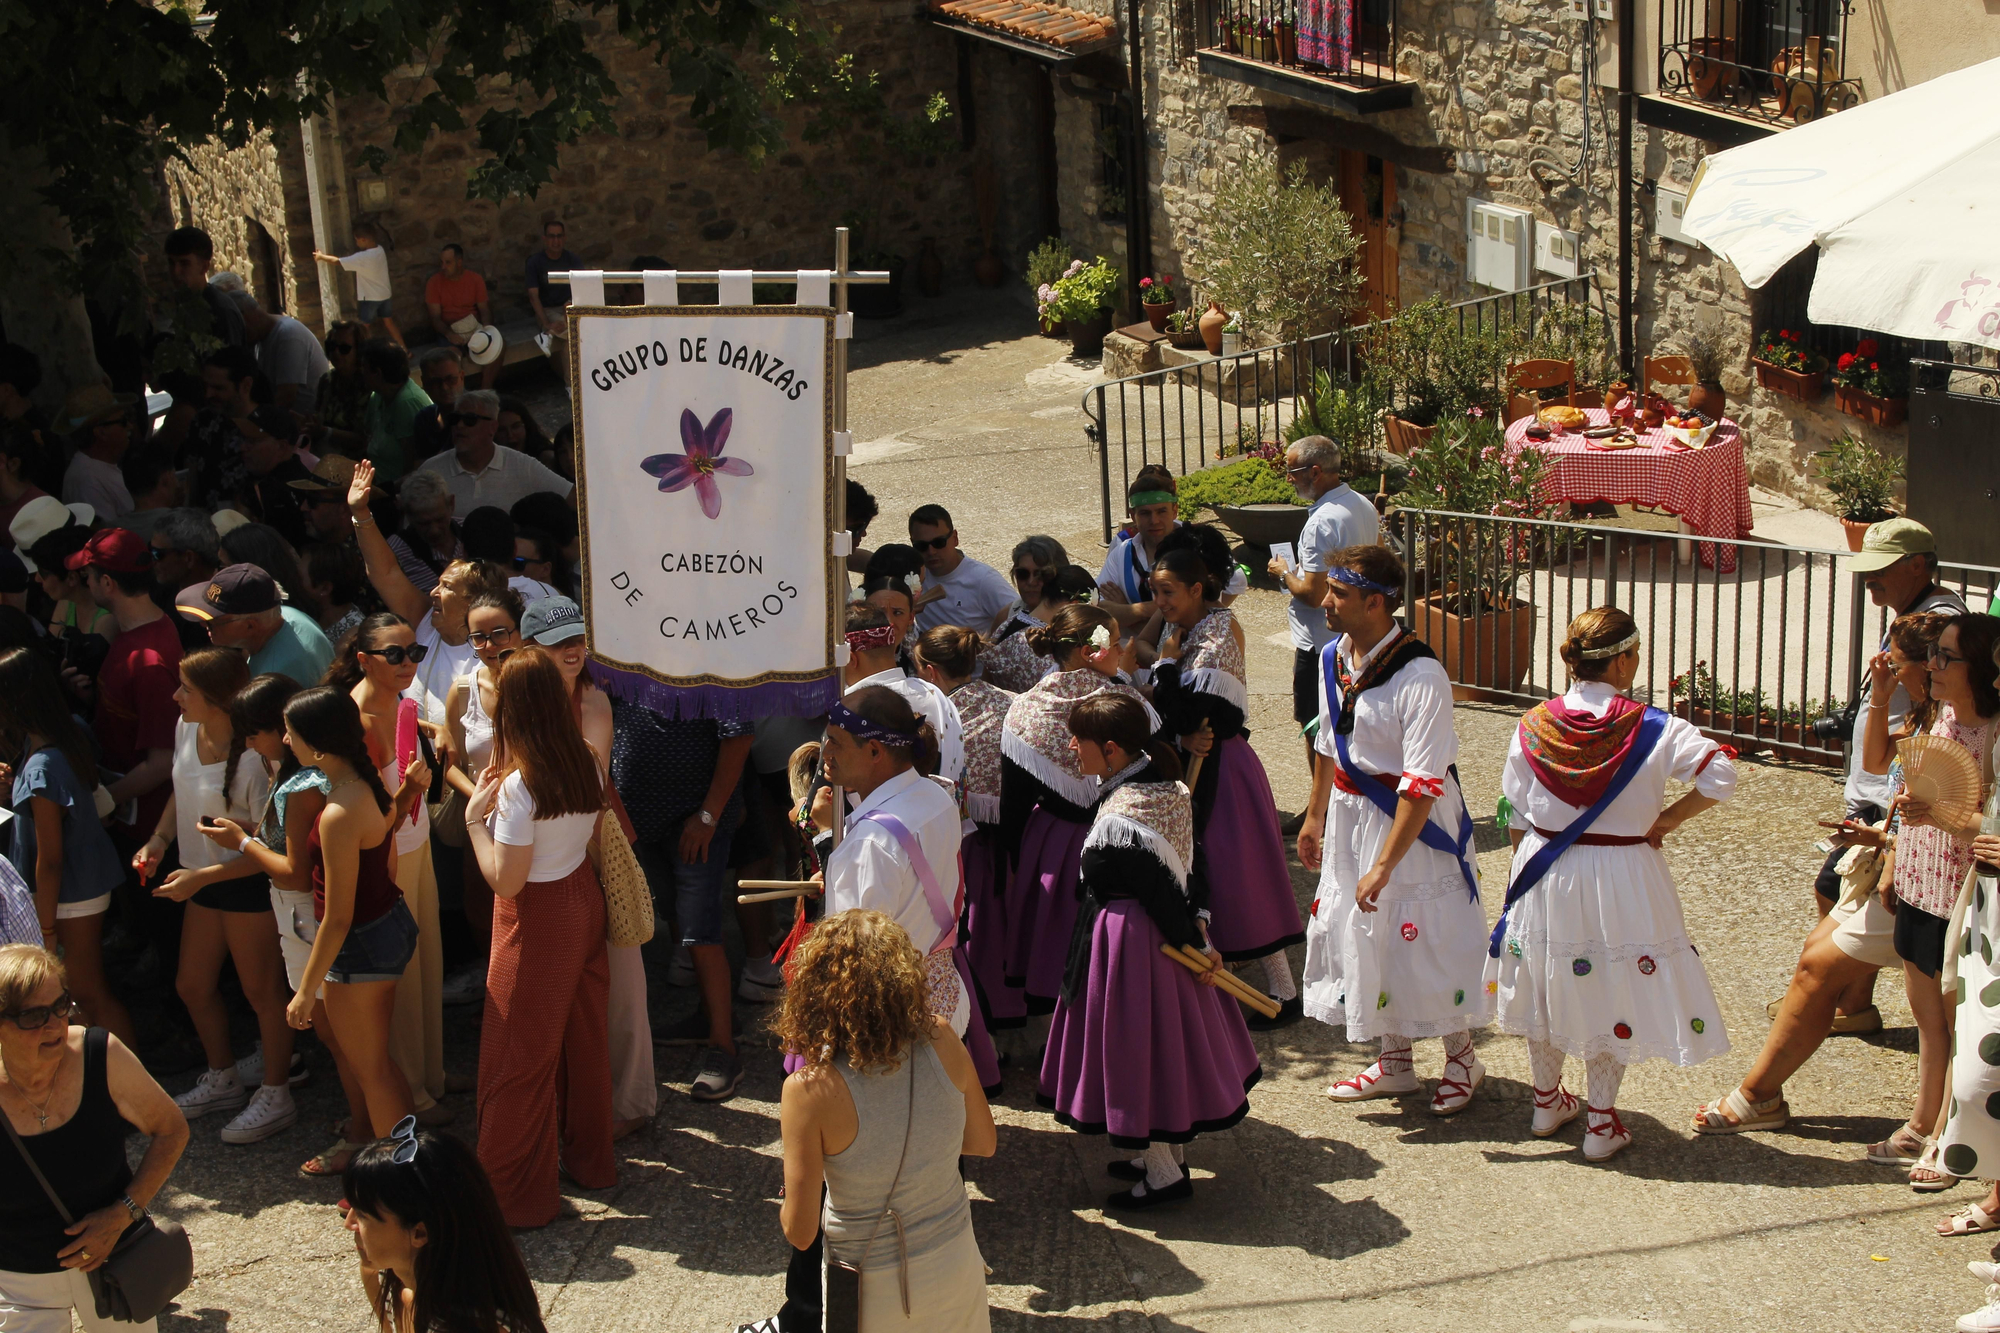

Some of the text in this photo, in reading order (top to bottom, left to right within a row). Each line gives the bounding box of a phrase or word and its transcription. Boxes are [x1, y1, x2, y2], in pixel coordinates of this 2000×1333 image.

[590, 337, 809, 401] GRUPO DE DANZAS
[660, 549, 763, 574] CABEZÓN
[610, 570, 799, 641] DE CAMEROS
